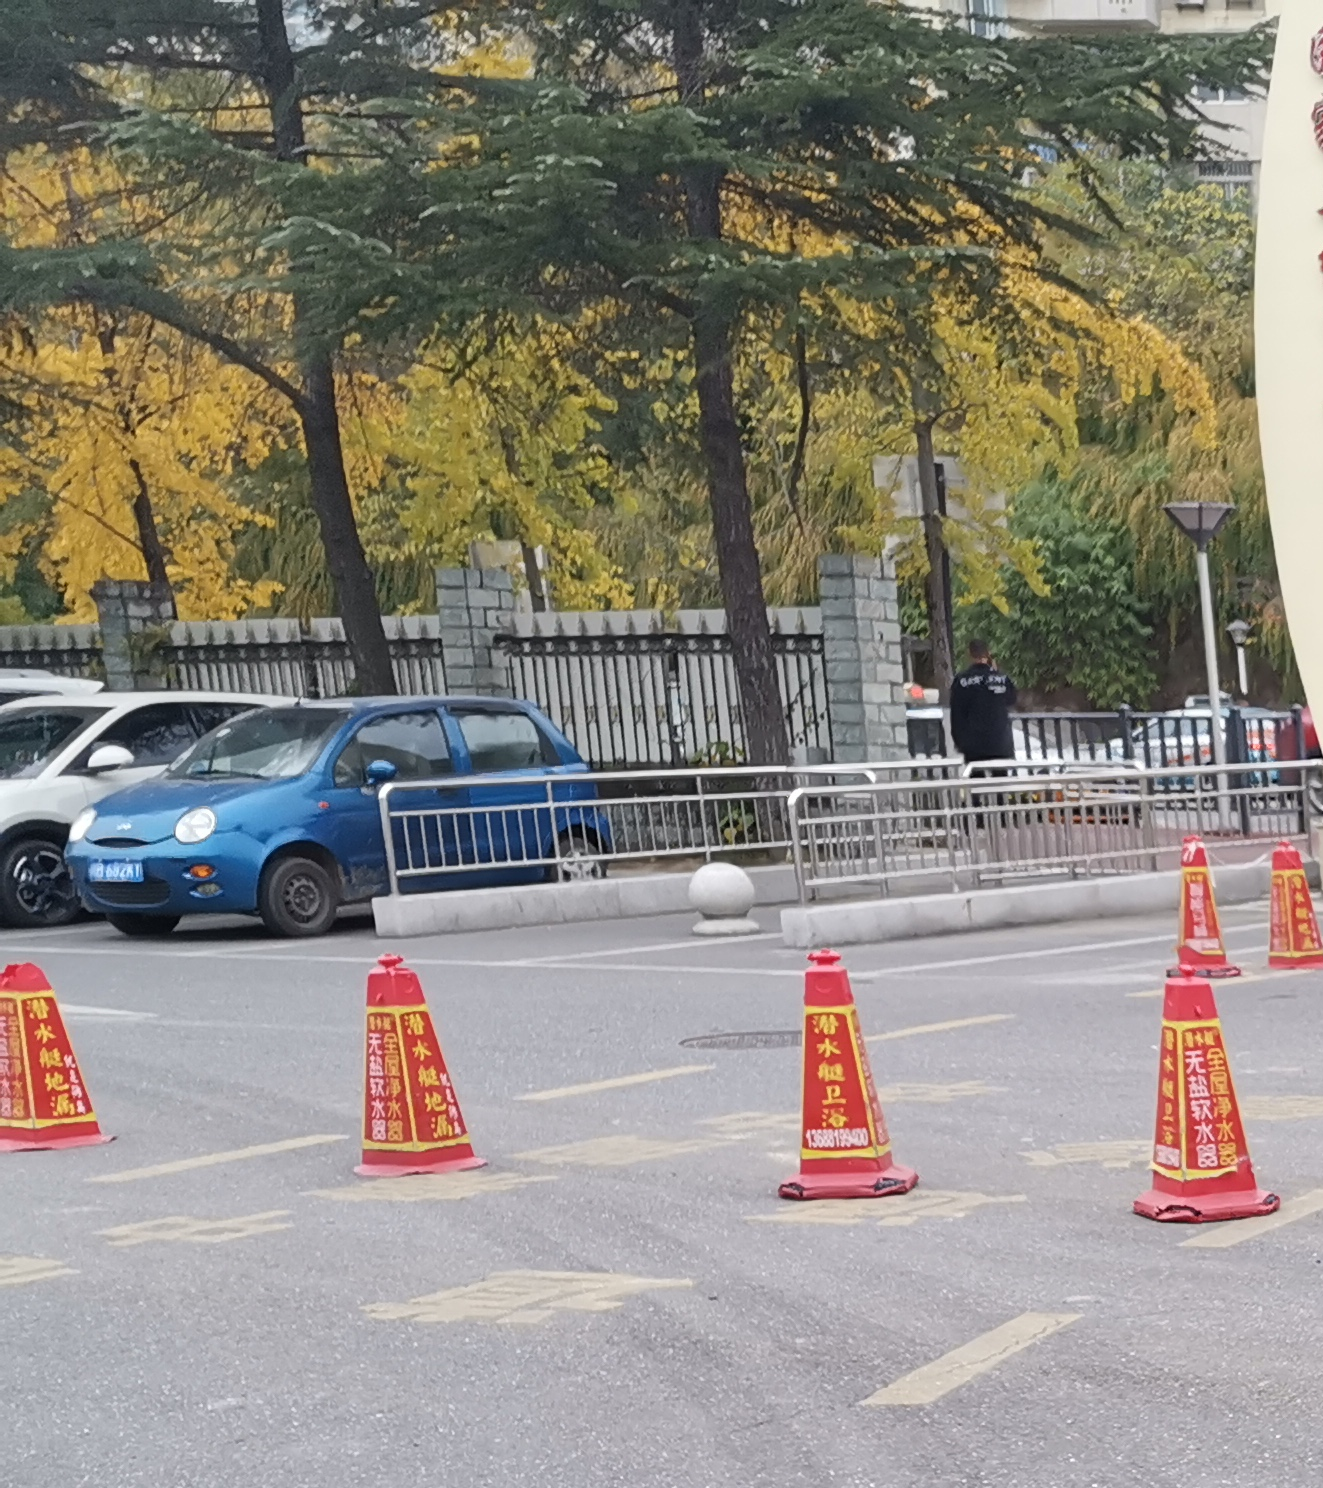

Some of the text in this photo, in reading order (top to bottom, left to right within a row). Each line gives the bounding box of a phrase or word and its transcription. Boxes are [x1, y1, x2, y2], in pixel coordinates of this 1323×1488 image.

[1185, 1050, 1219, 1168] 无盐软水器
